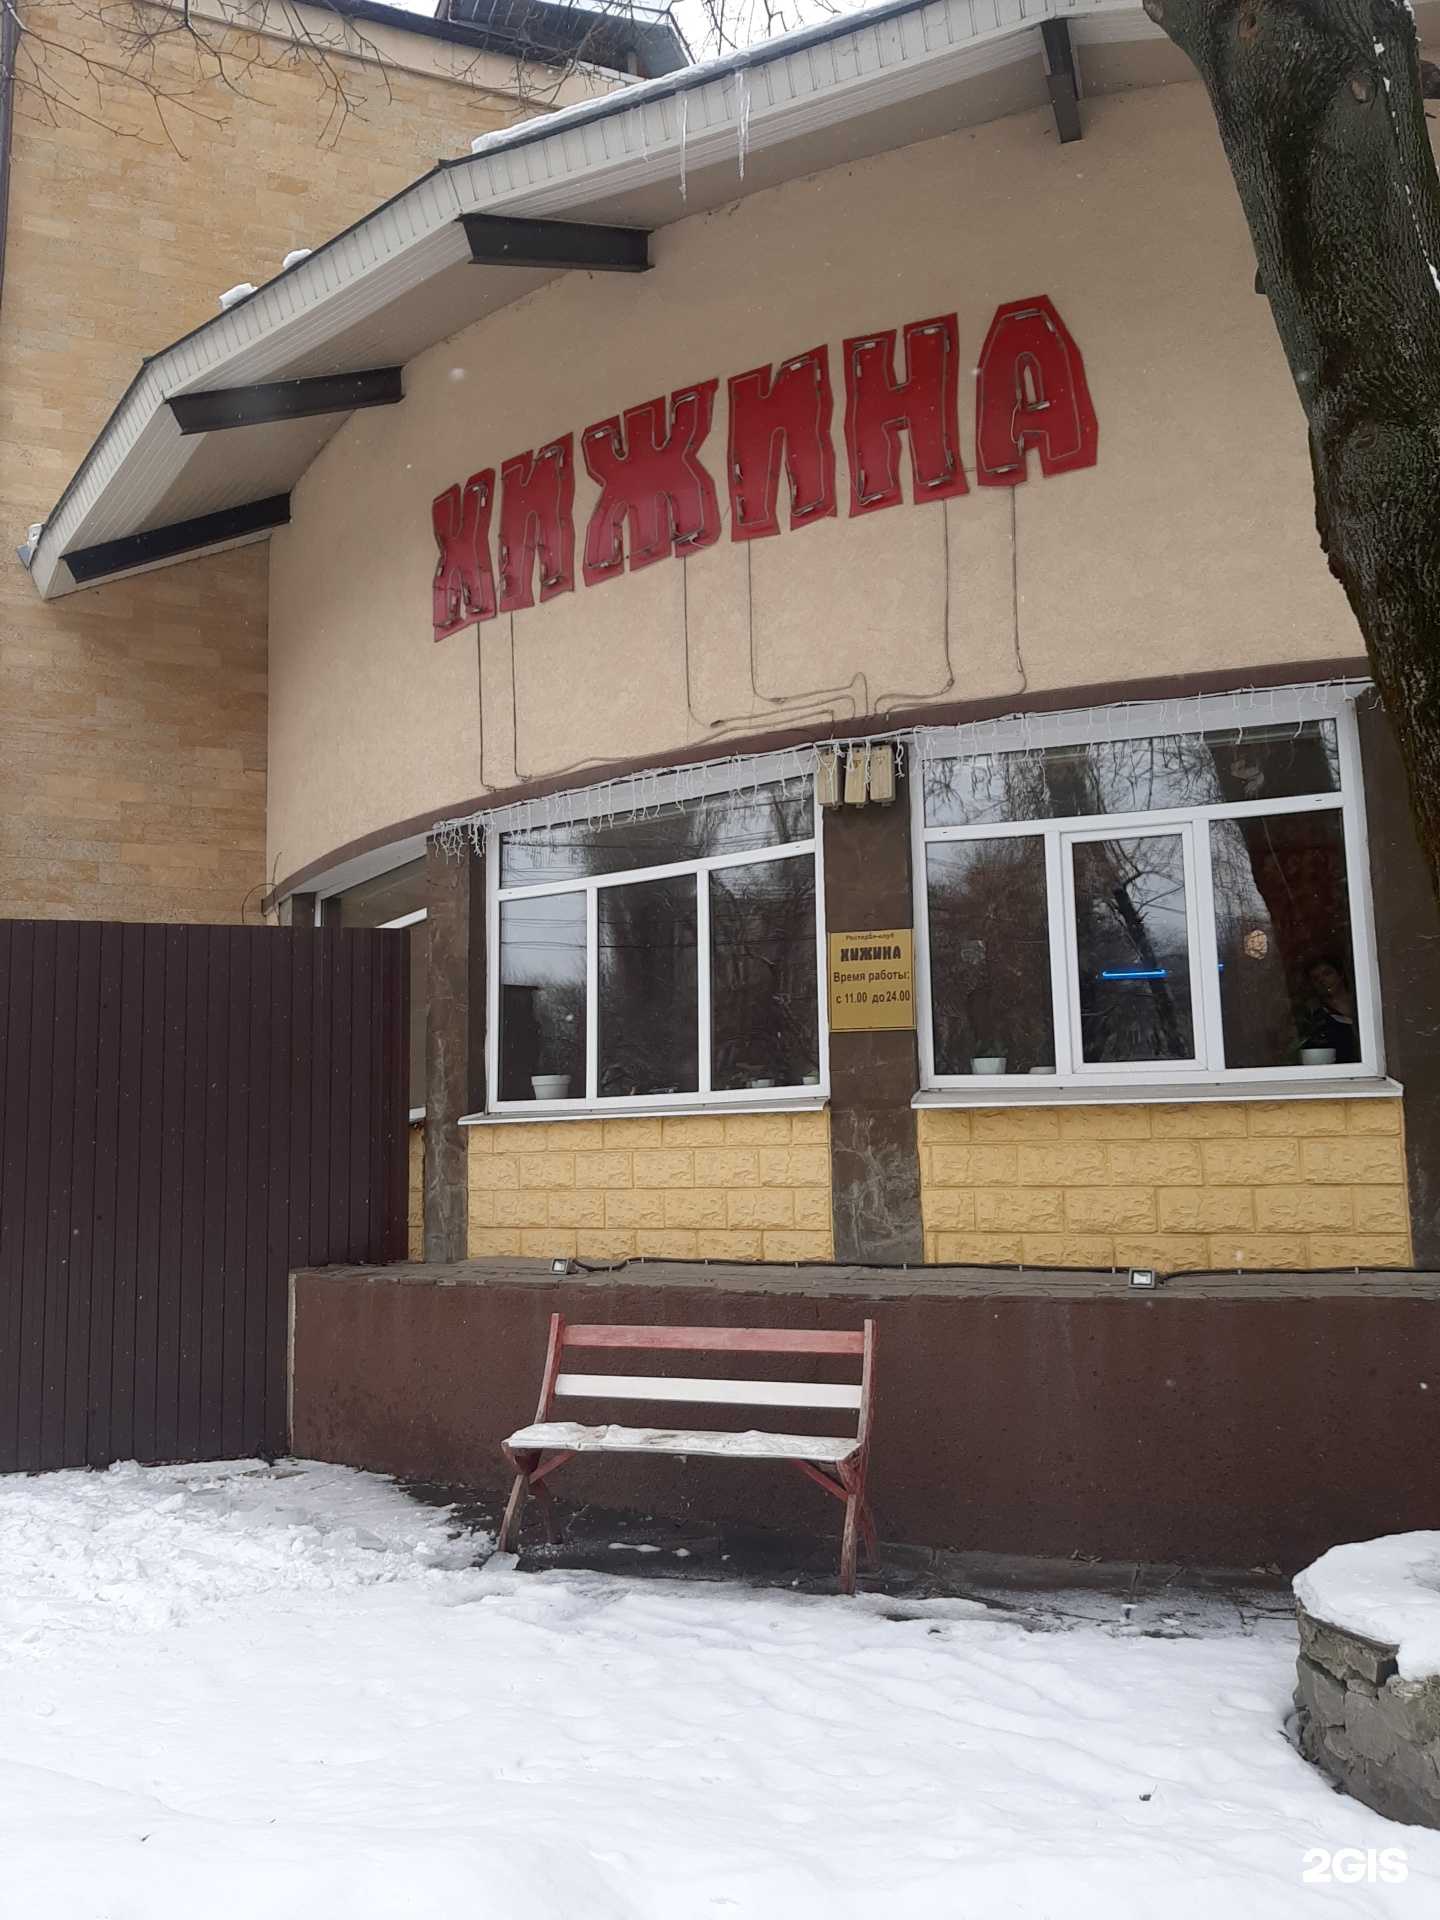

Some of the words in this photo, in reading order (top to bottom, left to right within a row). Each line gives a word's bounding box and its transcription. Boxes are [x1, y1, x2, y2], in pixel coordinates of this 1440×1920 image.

[431, 294, 1099, 643] ХИЖИНА
[841, 946, 901, 962] ХИЖИНА
[833, 971, 866, 984] Время
[868, 970, 909, 983] работы:
[836, 995, 842, 1004] с
[845, 991, 868, 1003] 11.00
[872, 994, 885, 1004] до
[886, 990, 910, 1002] 24.00
